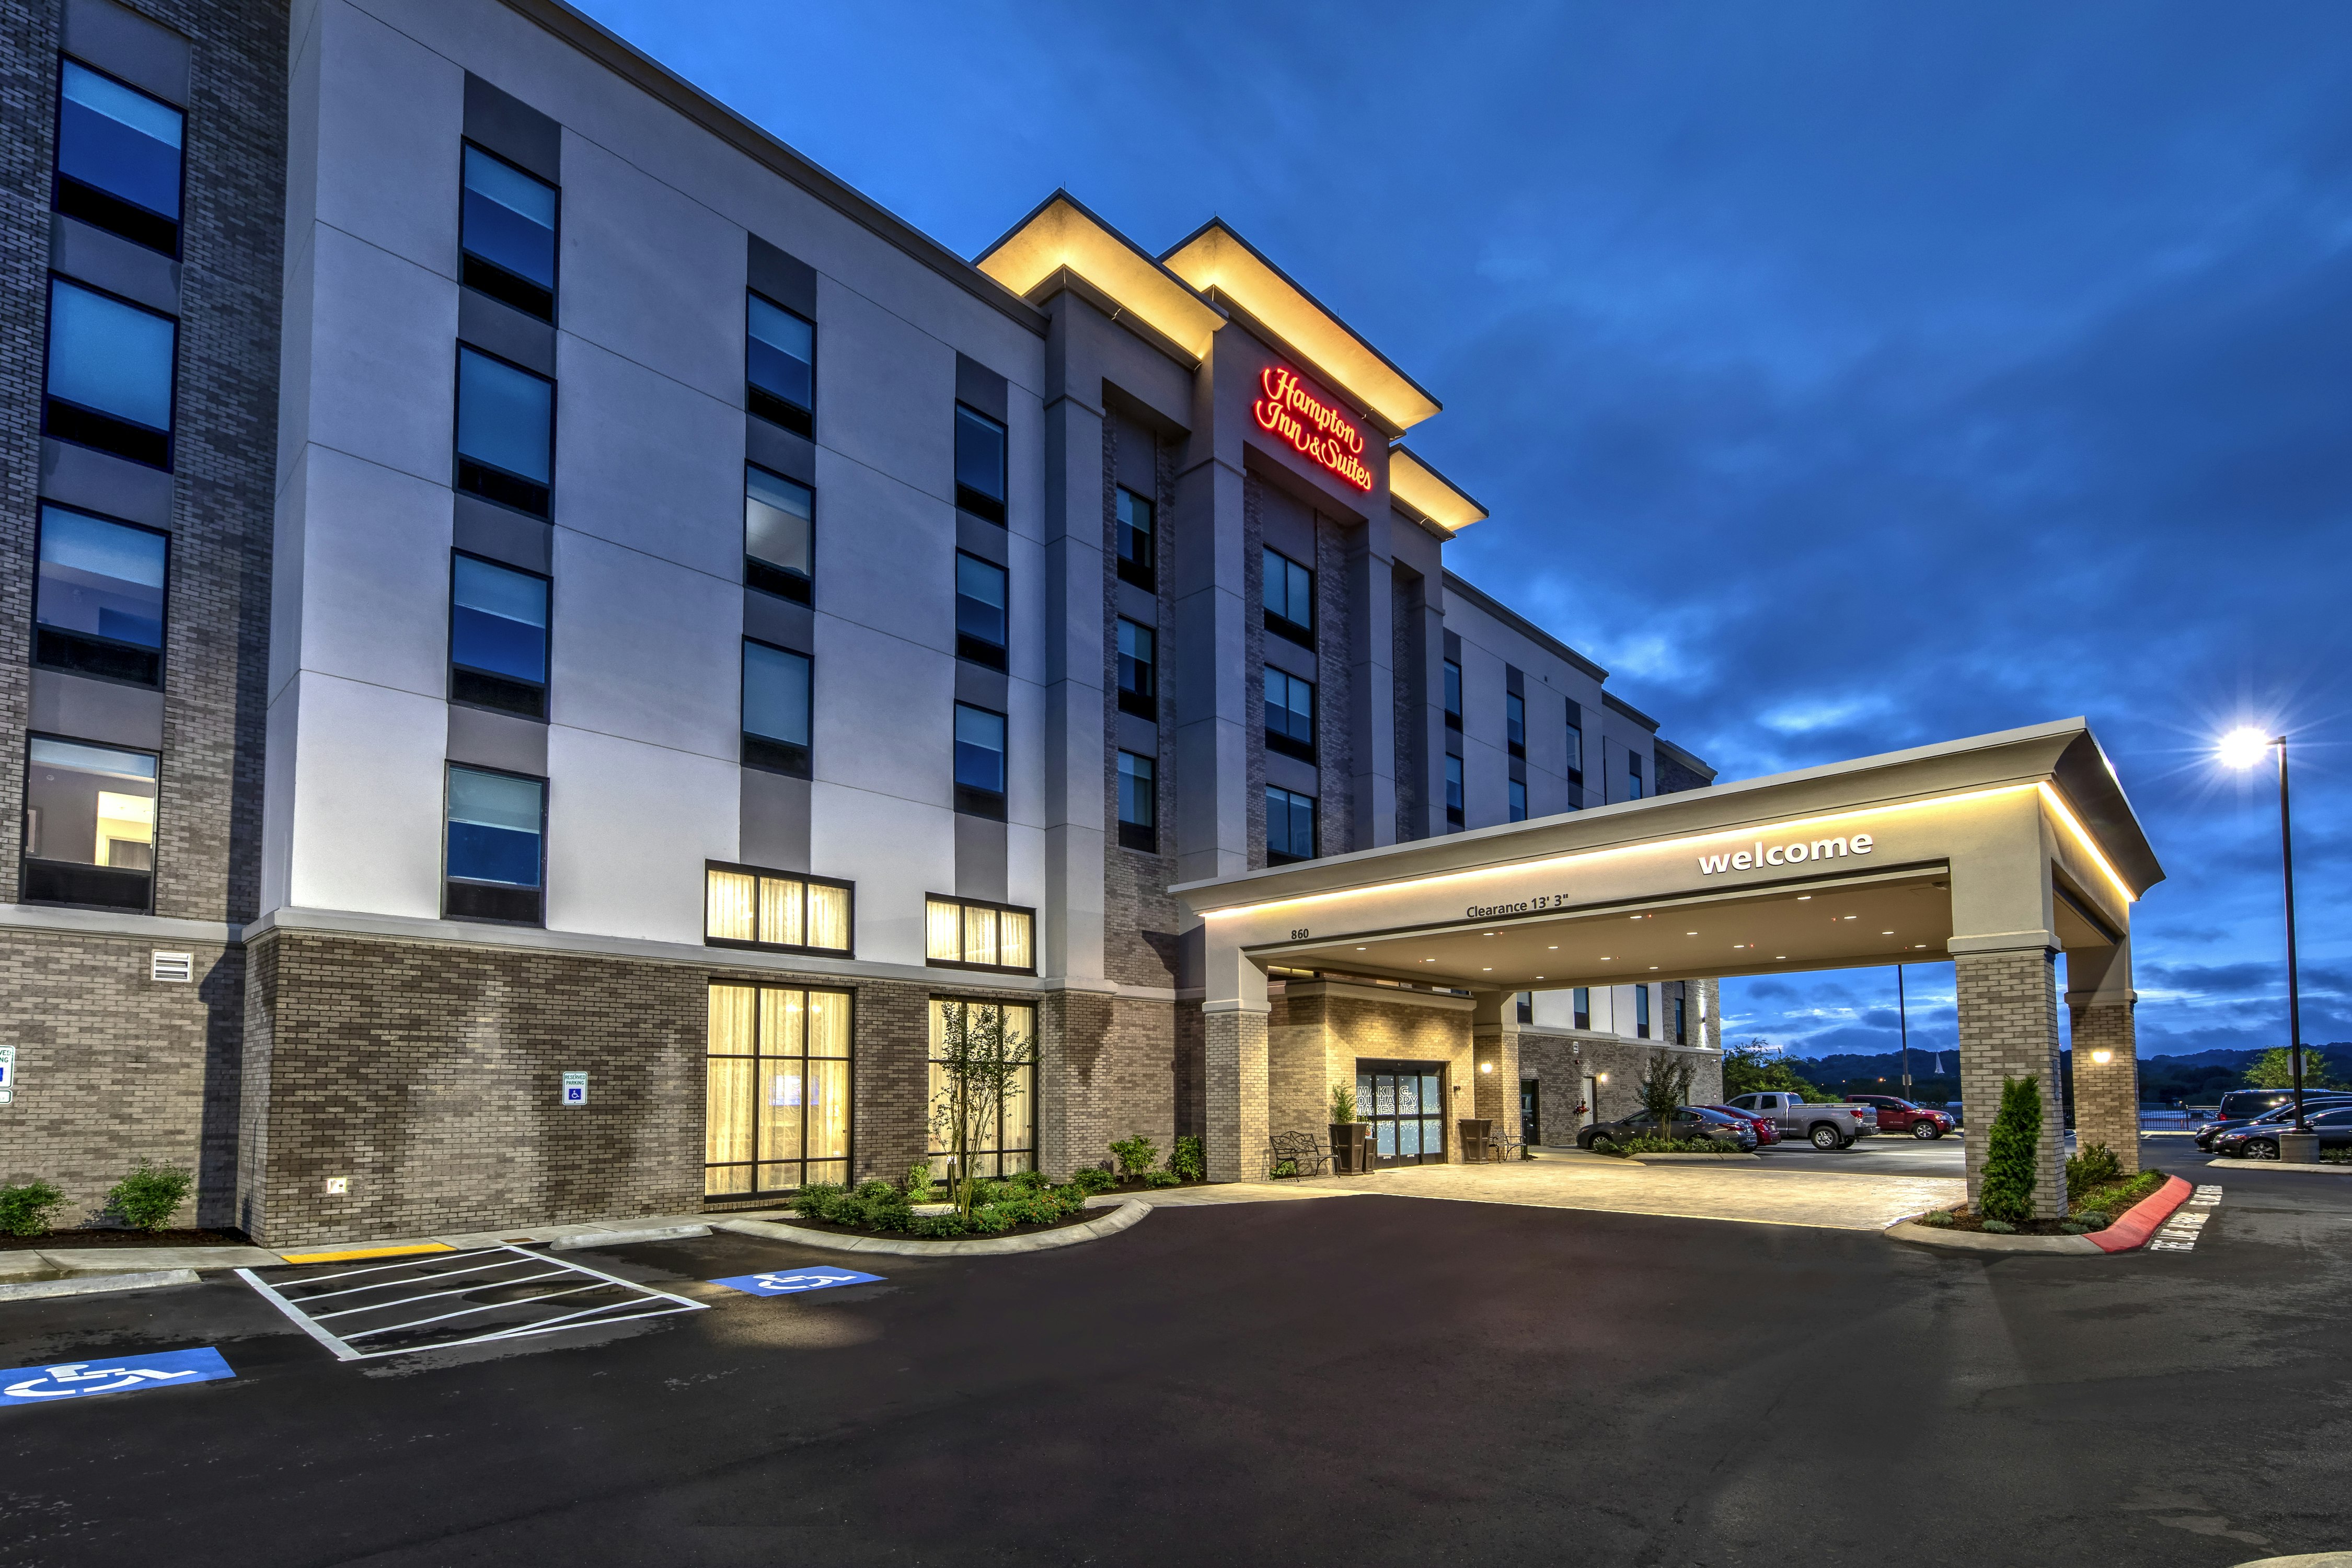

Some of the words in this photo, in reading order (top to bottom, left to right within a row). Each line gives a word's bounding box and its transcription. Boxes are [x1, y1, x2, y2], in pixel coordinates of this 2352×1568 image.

[1263, 368, 1363, 453] Hampton
[1255, 400, 1310, 451] Inn
[1321, 439, 1371, 490] Suites
[1698, 833, 1873, 875] welcome
[1467, 902, 1527, 918] Clearance
[1531, 896, 1550, 909] 13'
[1554, 893, 1569, 907] 3"
[1291, 928, 1309, 940] 860
[1356, 1096, 1373, 1106] OU
[2158, 1229, 2199, 1240] LANE
[2150, 1240, 2195, 1252] FIRE
